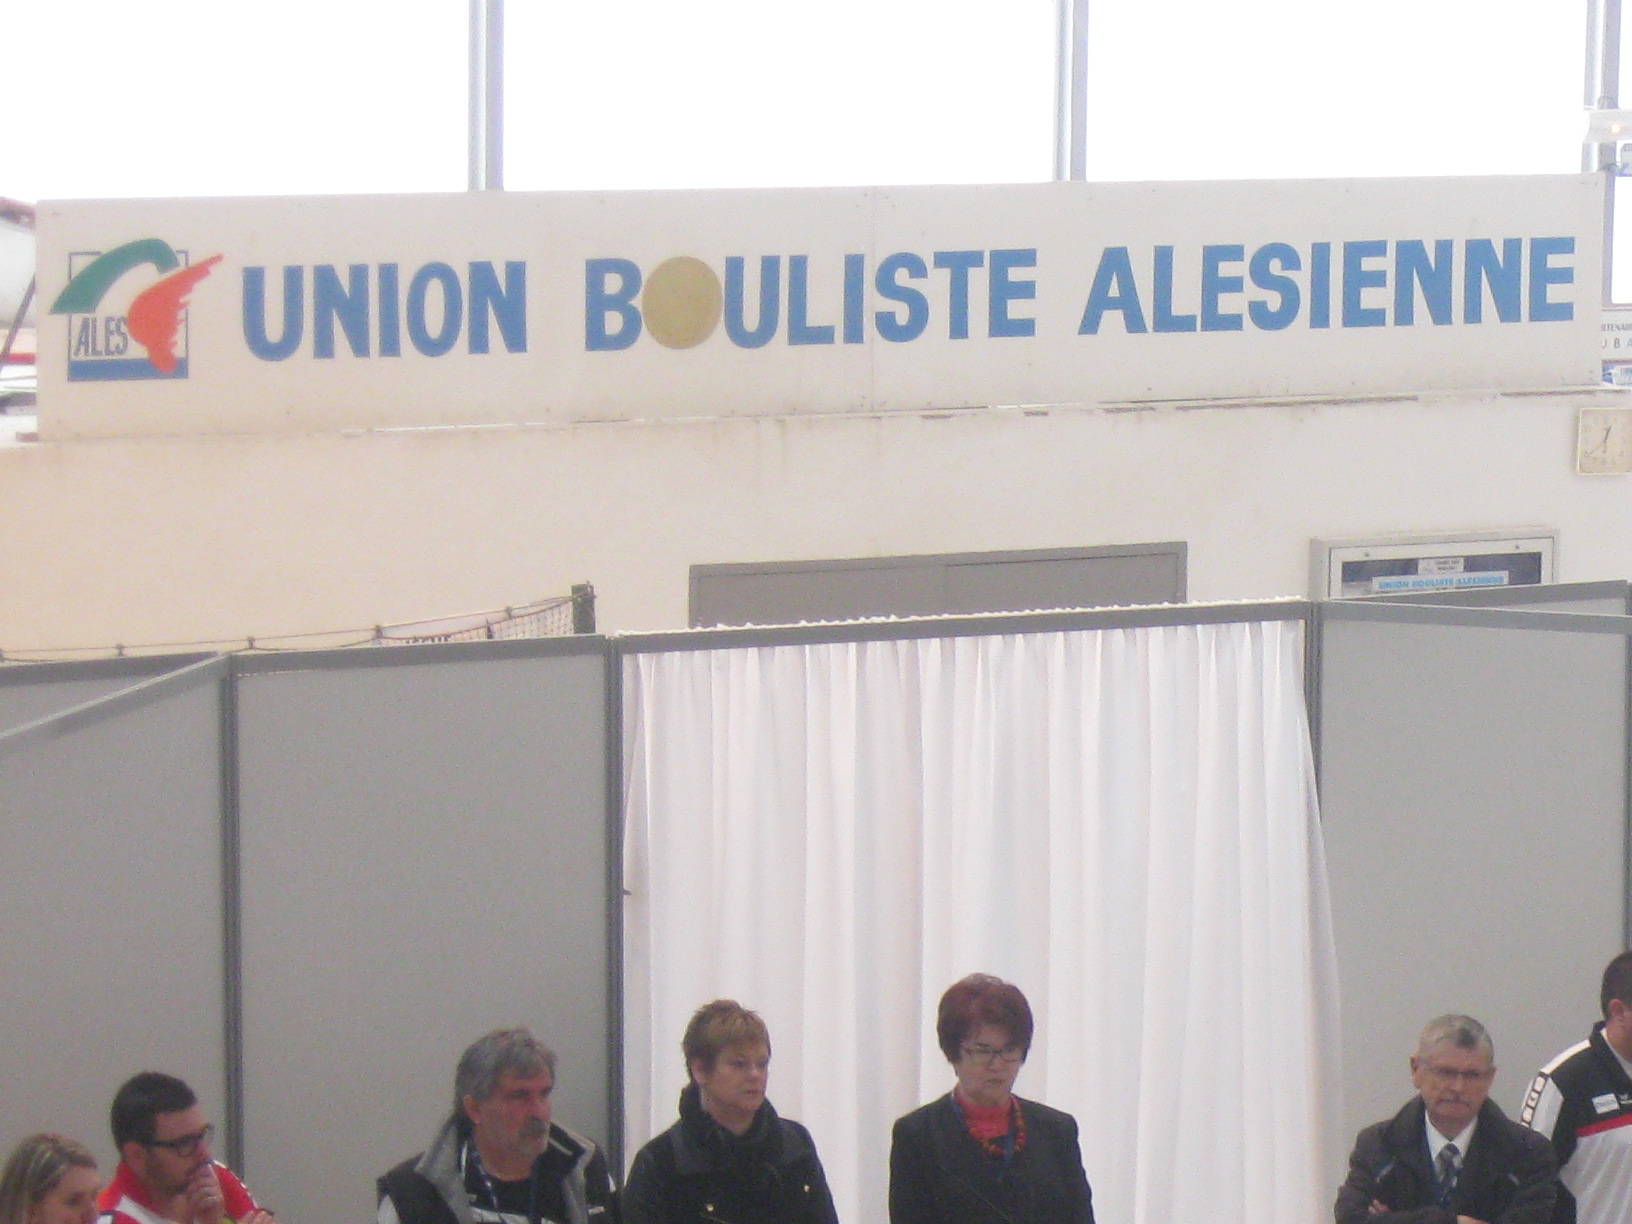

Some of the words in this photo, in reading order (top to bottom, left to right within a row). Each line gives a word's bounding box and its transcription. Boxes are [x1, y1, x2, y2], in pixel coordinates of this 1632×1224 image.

[73, 316, 129, 357] ALES
[243, 261, 527, 361] UNION
[585, 250, 1037, 351] BOULISTE
[1079, 237, 1576, 335] ALESIENNE
